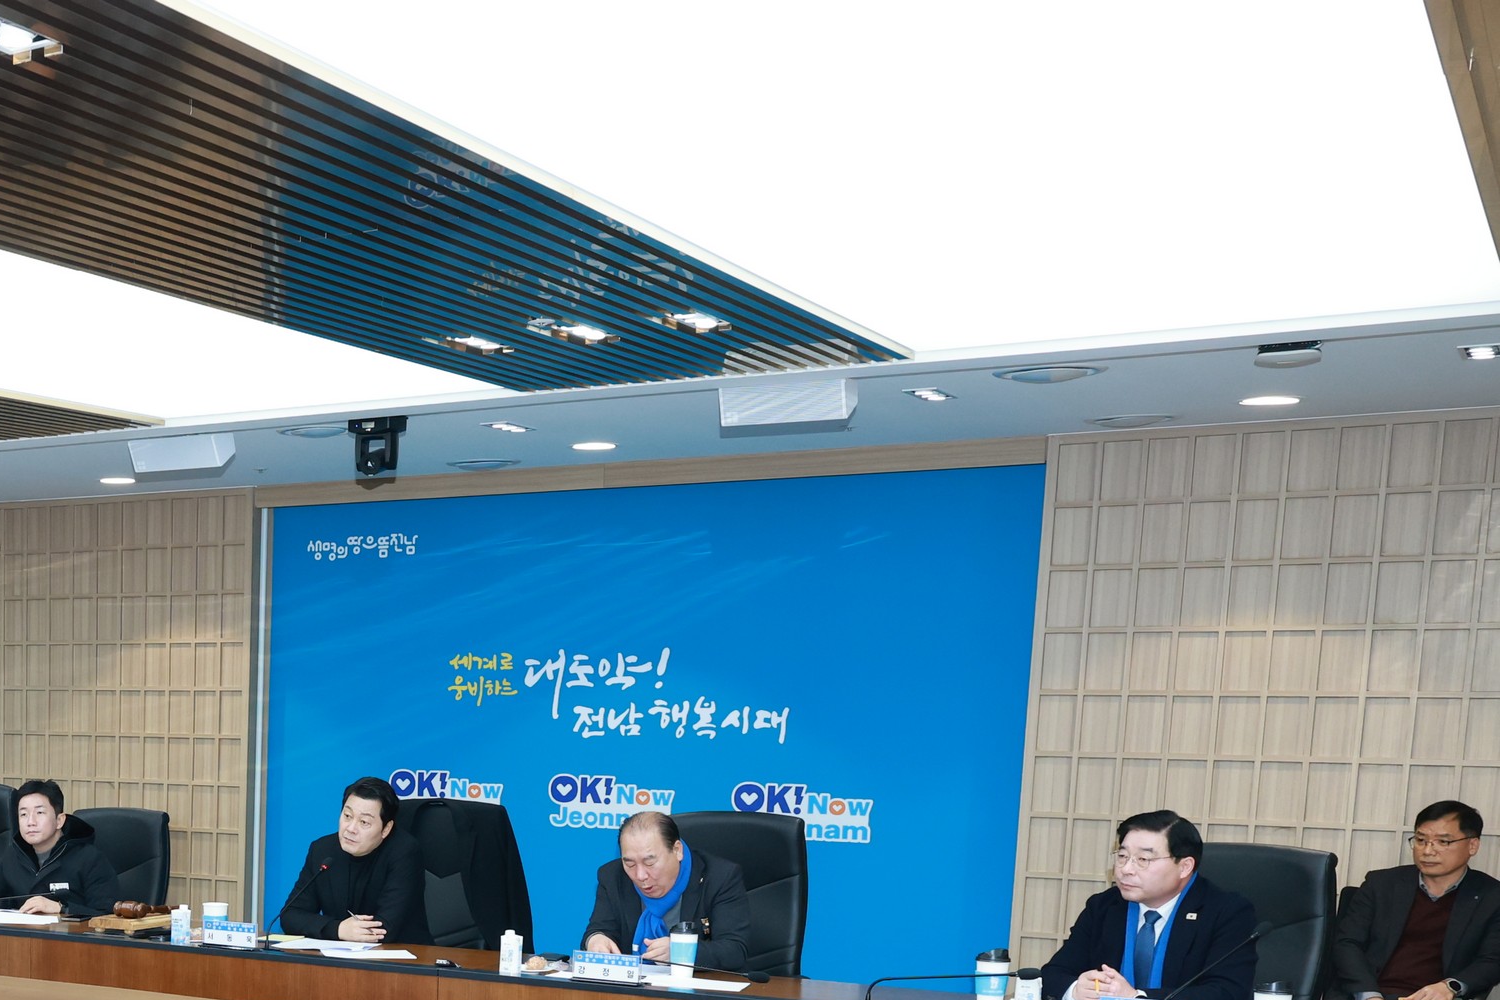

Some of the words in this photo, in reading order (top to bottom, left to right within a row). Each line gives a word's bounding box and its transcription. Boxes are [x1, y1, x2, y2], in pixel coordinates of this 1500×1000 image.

[449, 652, 514, 672] 세계로
[448, 676, 518, 707] 웅비하는
[523, 647, 671, 719] 대도약!
[573, 702, 644, 738] 전남
[390, 770, 448, 798] OK!
[550, 775, 614, 805] OK!
[733, 783, 806, 815] OK!
[550, 806, 630, 827] Jeonn
